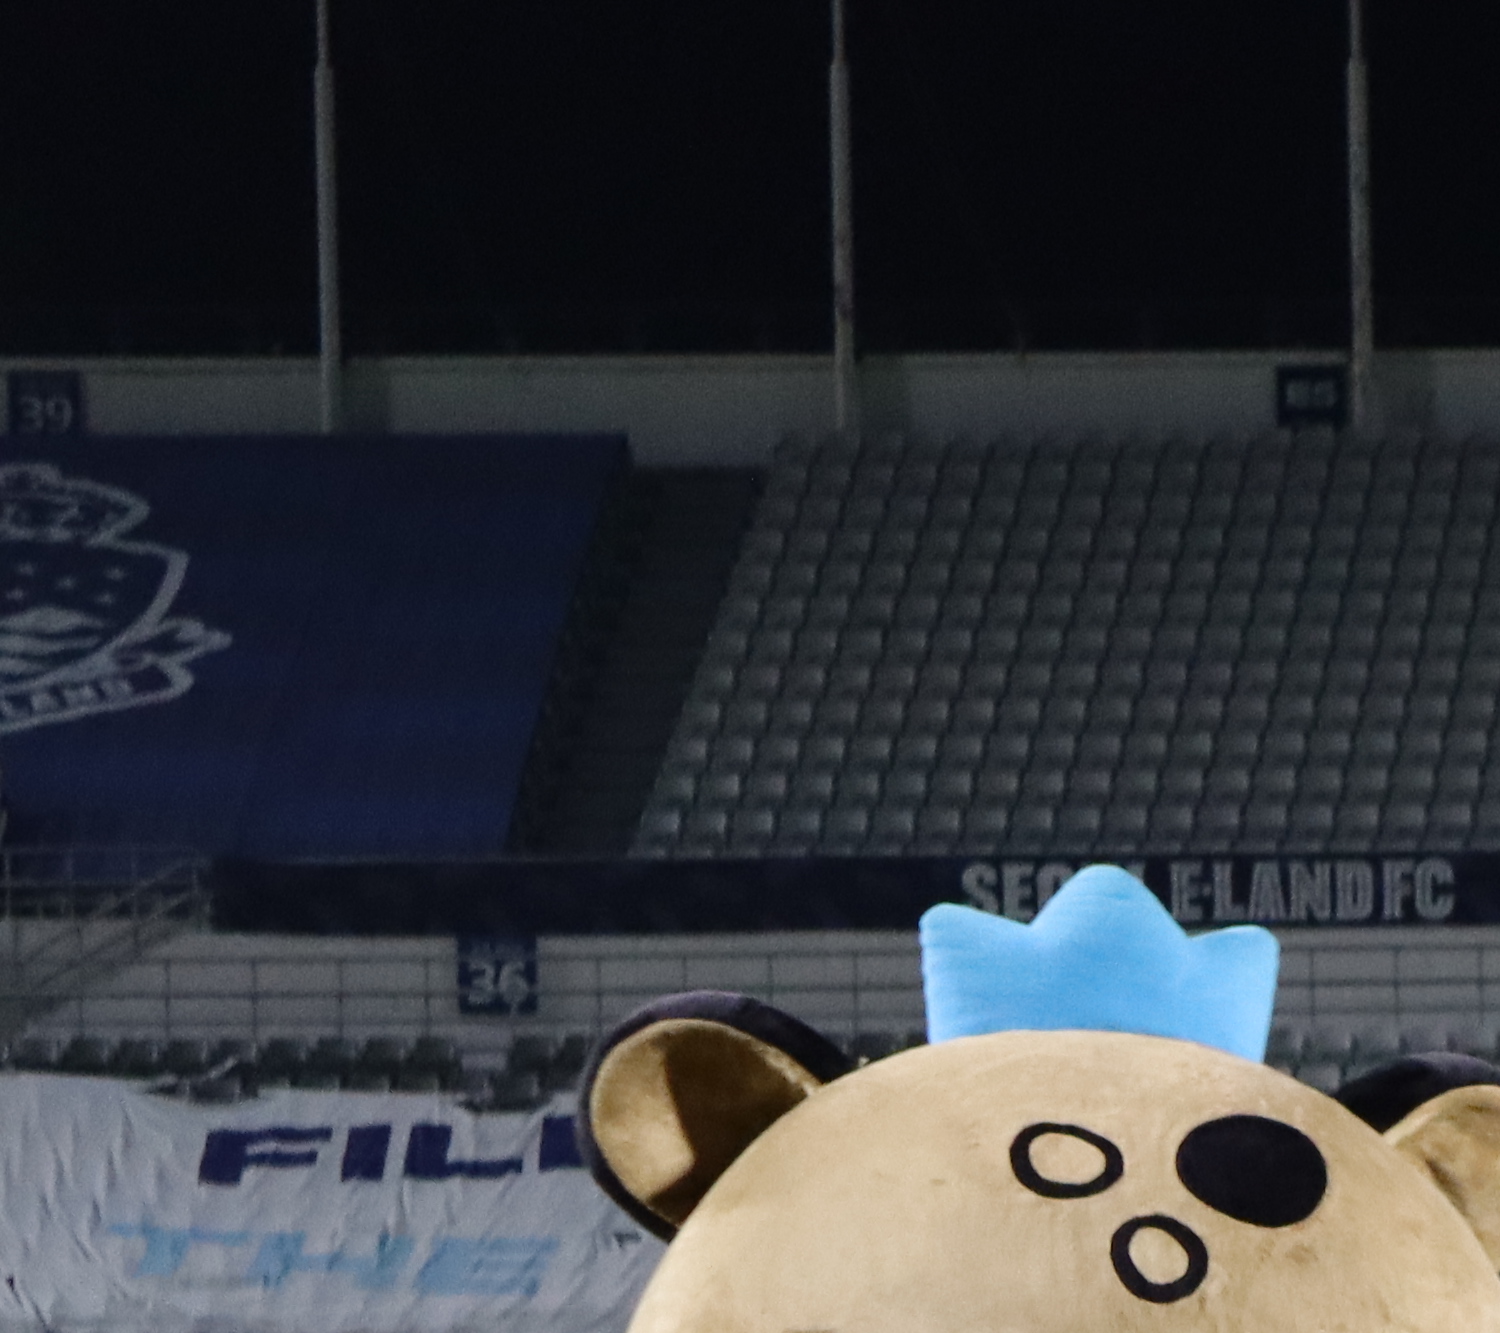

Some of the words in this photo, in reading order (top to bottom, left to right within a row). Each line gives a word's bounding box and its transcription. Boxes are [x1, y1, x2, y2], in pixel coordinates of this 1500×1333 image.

[18, 396, 73, 435] 39
[1381, 858, 1456, 919] FC
[468, 961, 529, 1005] 36
[108, 1221, 558, 1297] THE
